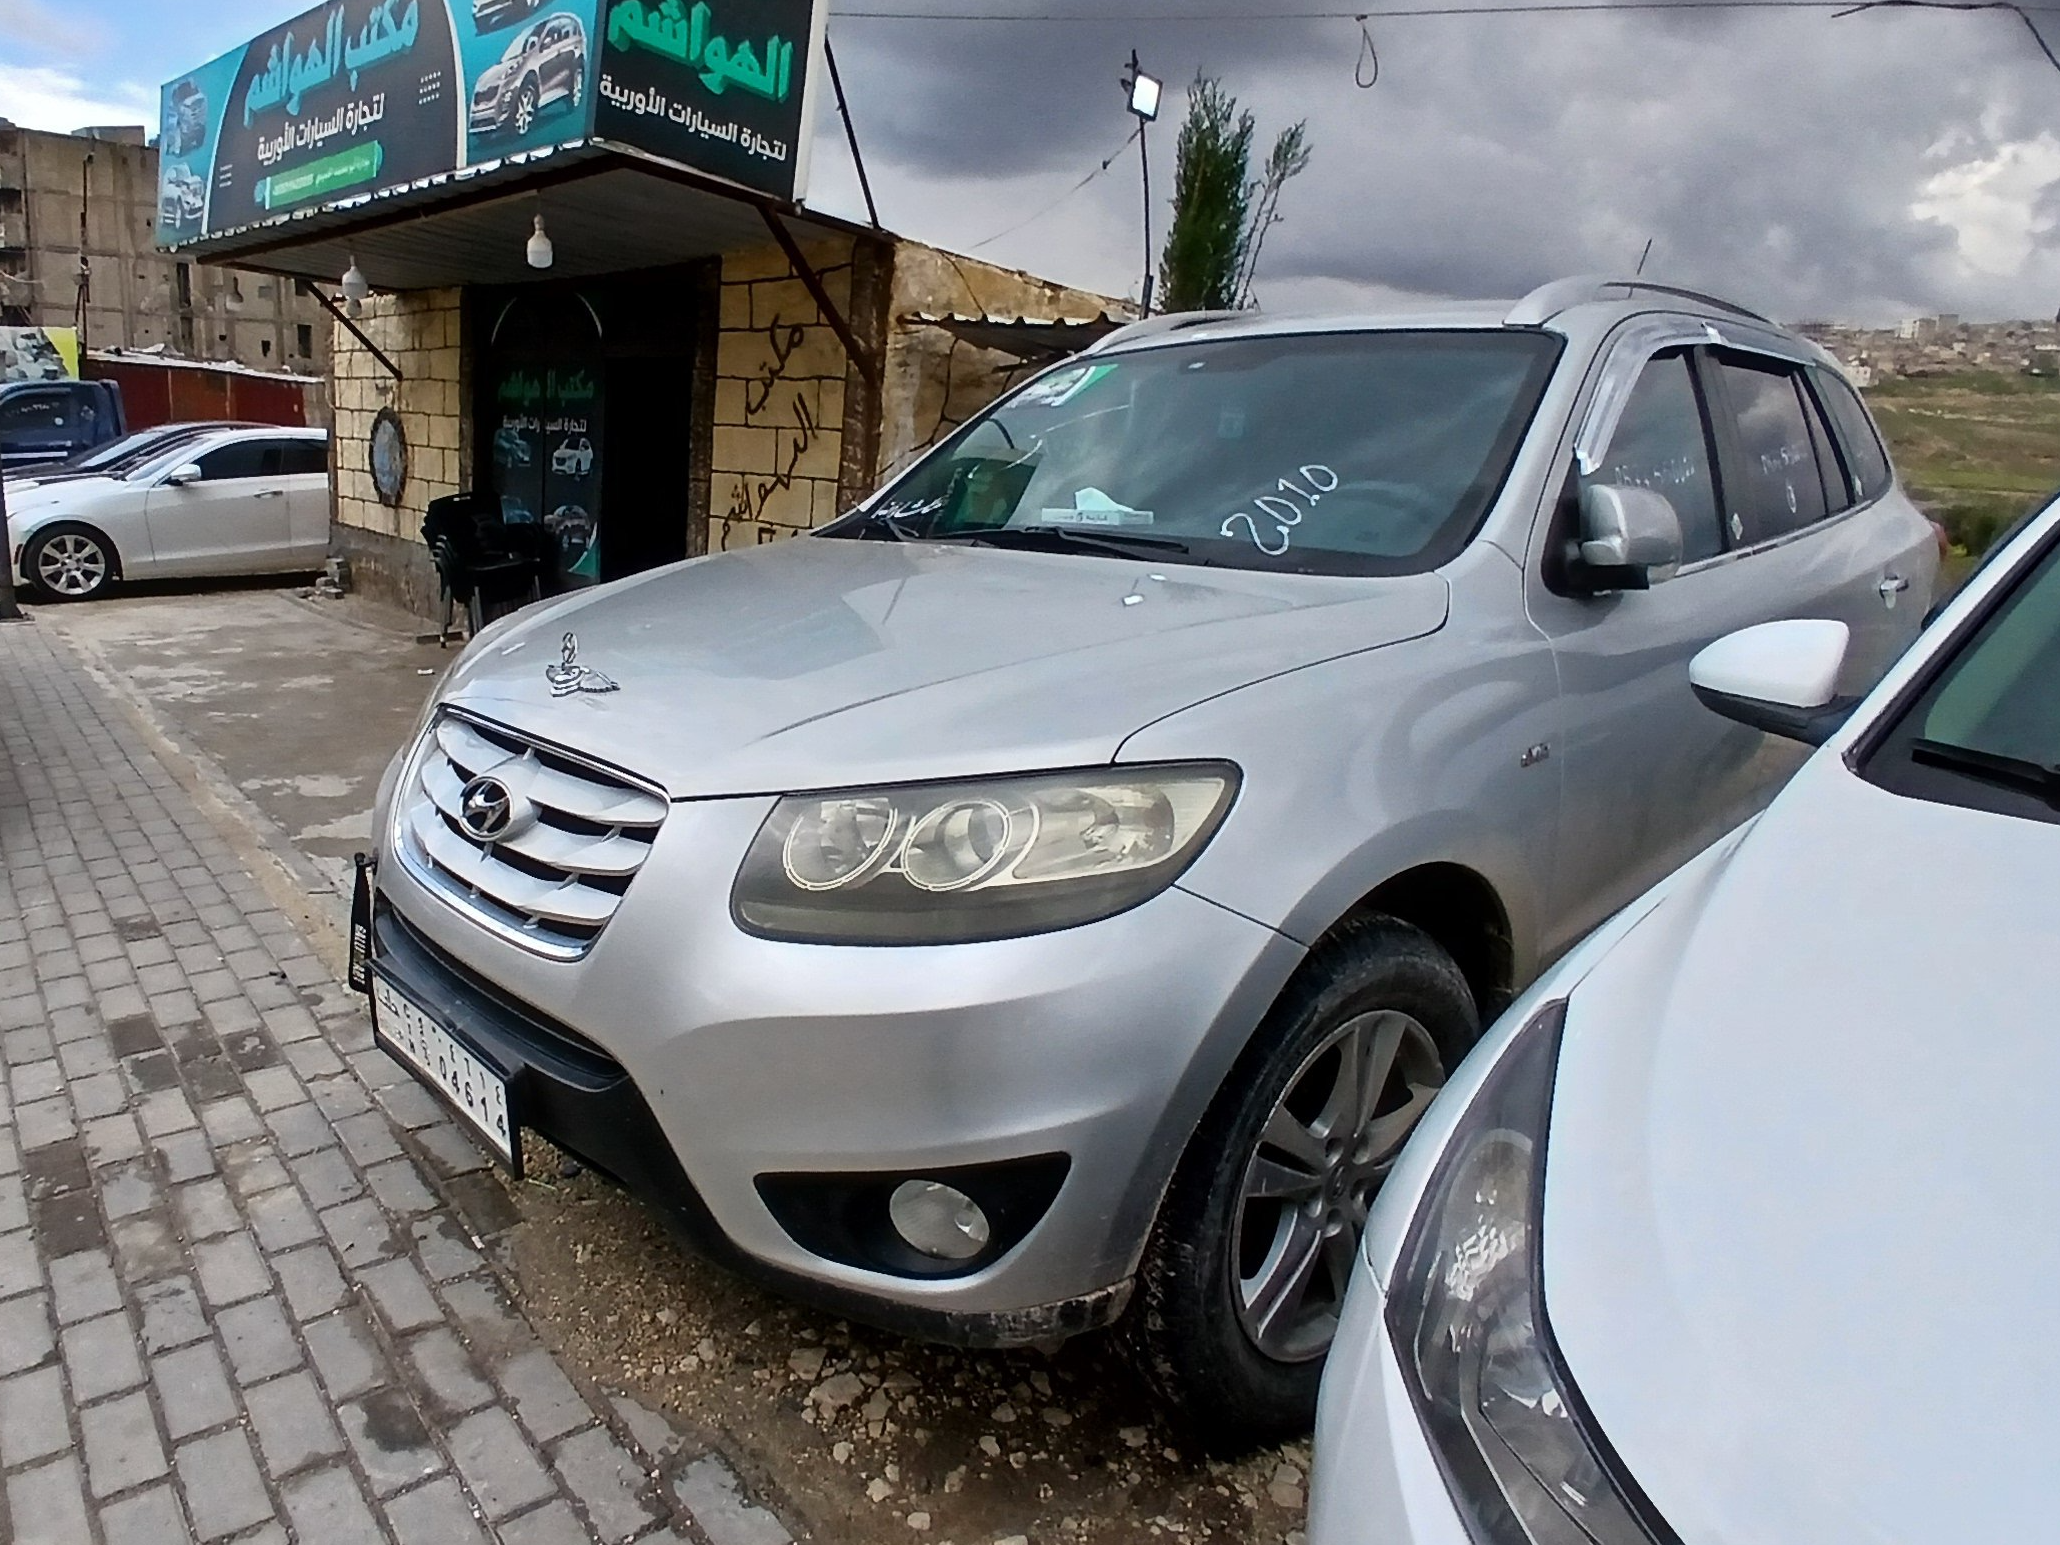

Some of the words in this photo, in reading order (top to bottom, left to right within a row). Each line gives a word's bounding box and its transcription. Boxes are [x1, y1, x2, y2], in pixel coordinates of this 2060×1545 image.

[345, 0, 419, 92] مكتب
[607, 0, 794, 103] الهواشم
[345, 93, 385, 136] لتجارة
[599, 73, 665, 117] الأوربية
[295, 105, 344, 150] السيارات
[668, 102, 737, 143] السيارات
[740, 126, 788, 162] لتجارة
[1219, 463, 1340, 556] 2010
